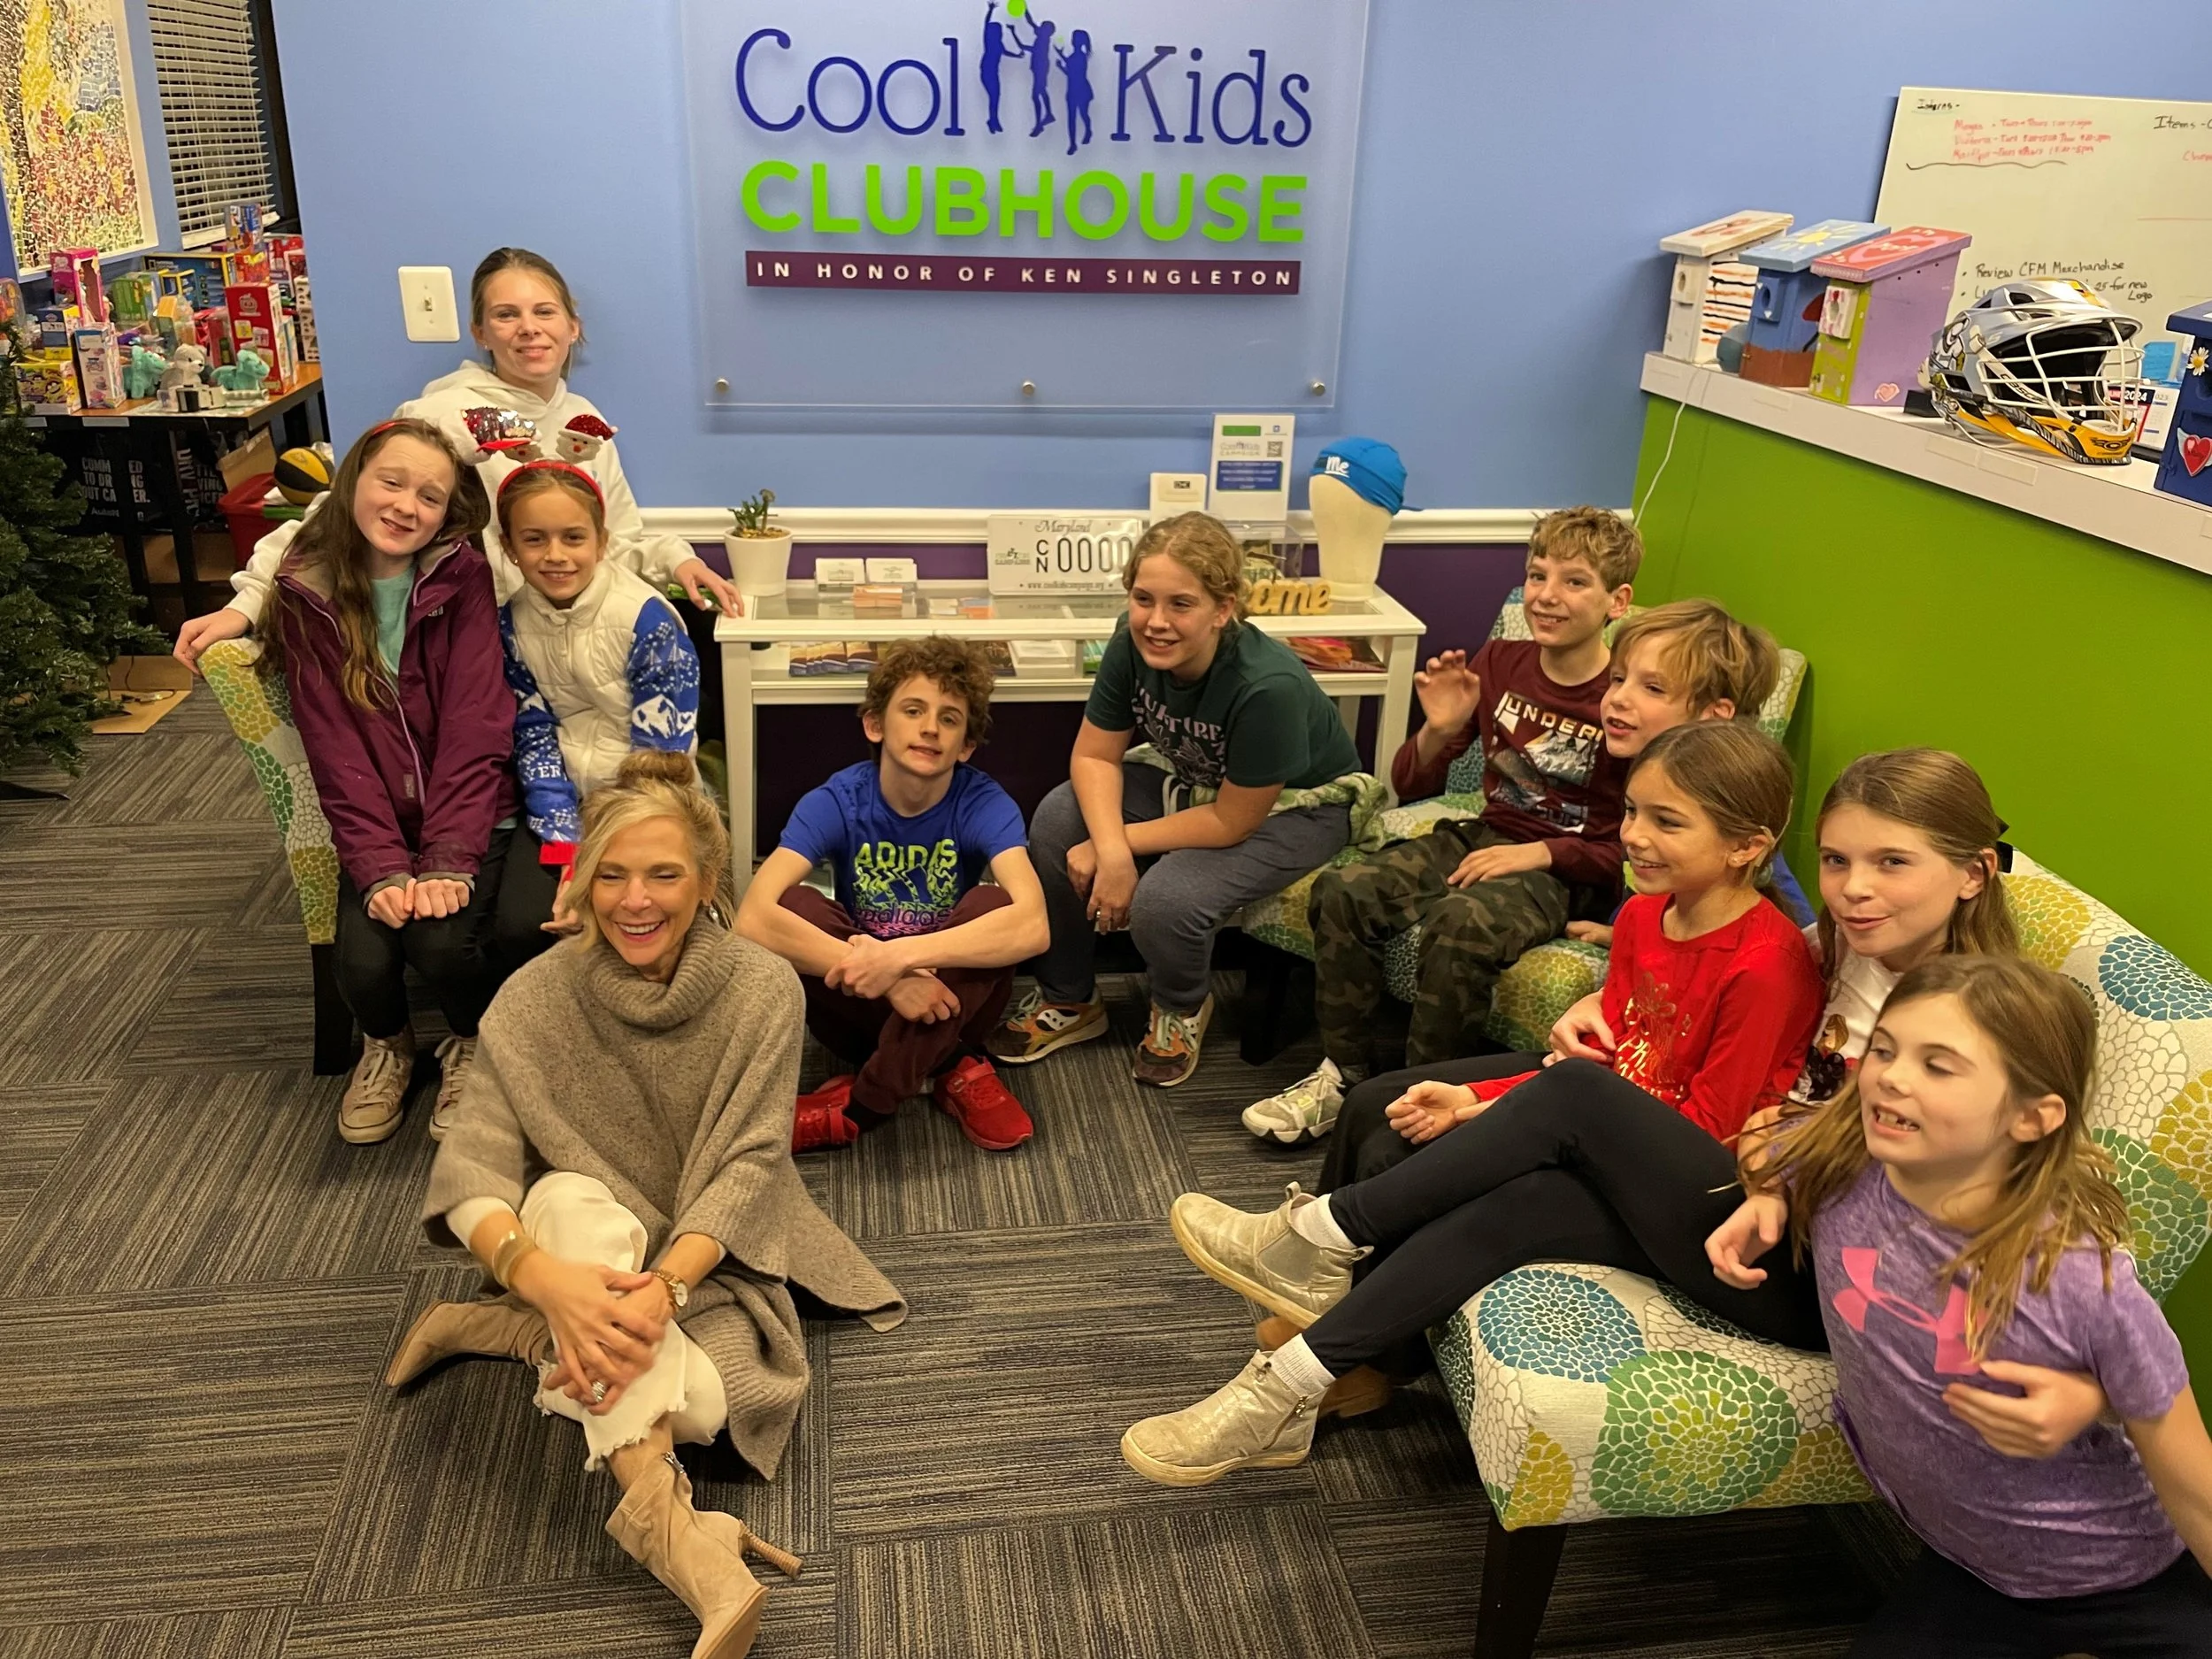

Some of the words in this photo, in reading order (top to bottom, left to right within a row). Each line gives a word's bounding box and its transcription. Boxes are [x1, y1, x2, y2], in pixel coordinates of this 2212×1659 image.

[736, 27, 966, 136] Cool
[1110, 43, 1312, 148] Kids
[2153, 115, 2196, 129] Items
[741, 159, 1308, 243] CLUBHOUSE
[757, 261, 790, 278] IN
[817, 263, 933, 281] HONOR
[957, 266, 995, 282] OF
[1020, 268, 1081, 284] KEN
[1105, 269, 1291, 286] SINGLETON
[1976, 263, 2014, 279] Review
[2018, 262, 2047, 277] CFM
[2052, 258, 2125, 274] Merchandise
[2109, 276, 2127, 291] for
[2128, 281, 2148, 290] new
[2127, 290, 2154, 303] Logo
[2124, 390, 2148, 402] 2024
[1034, 519, 1093, 535] Maryland
